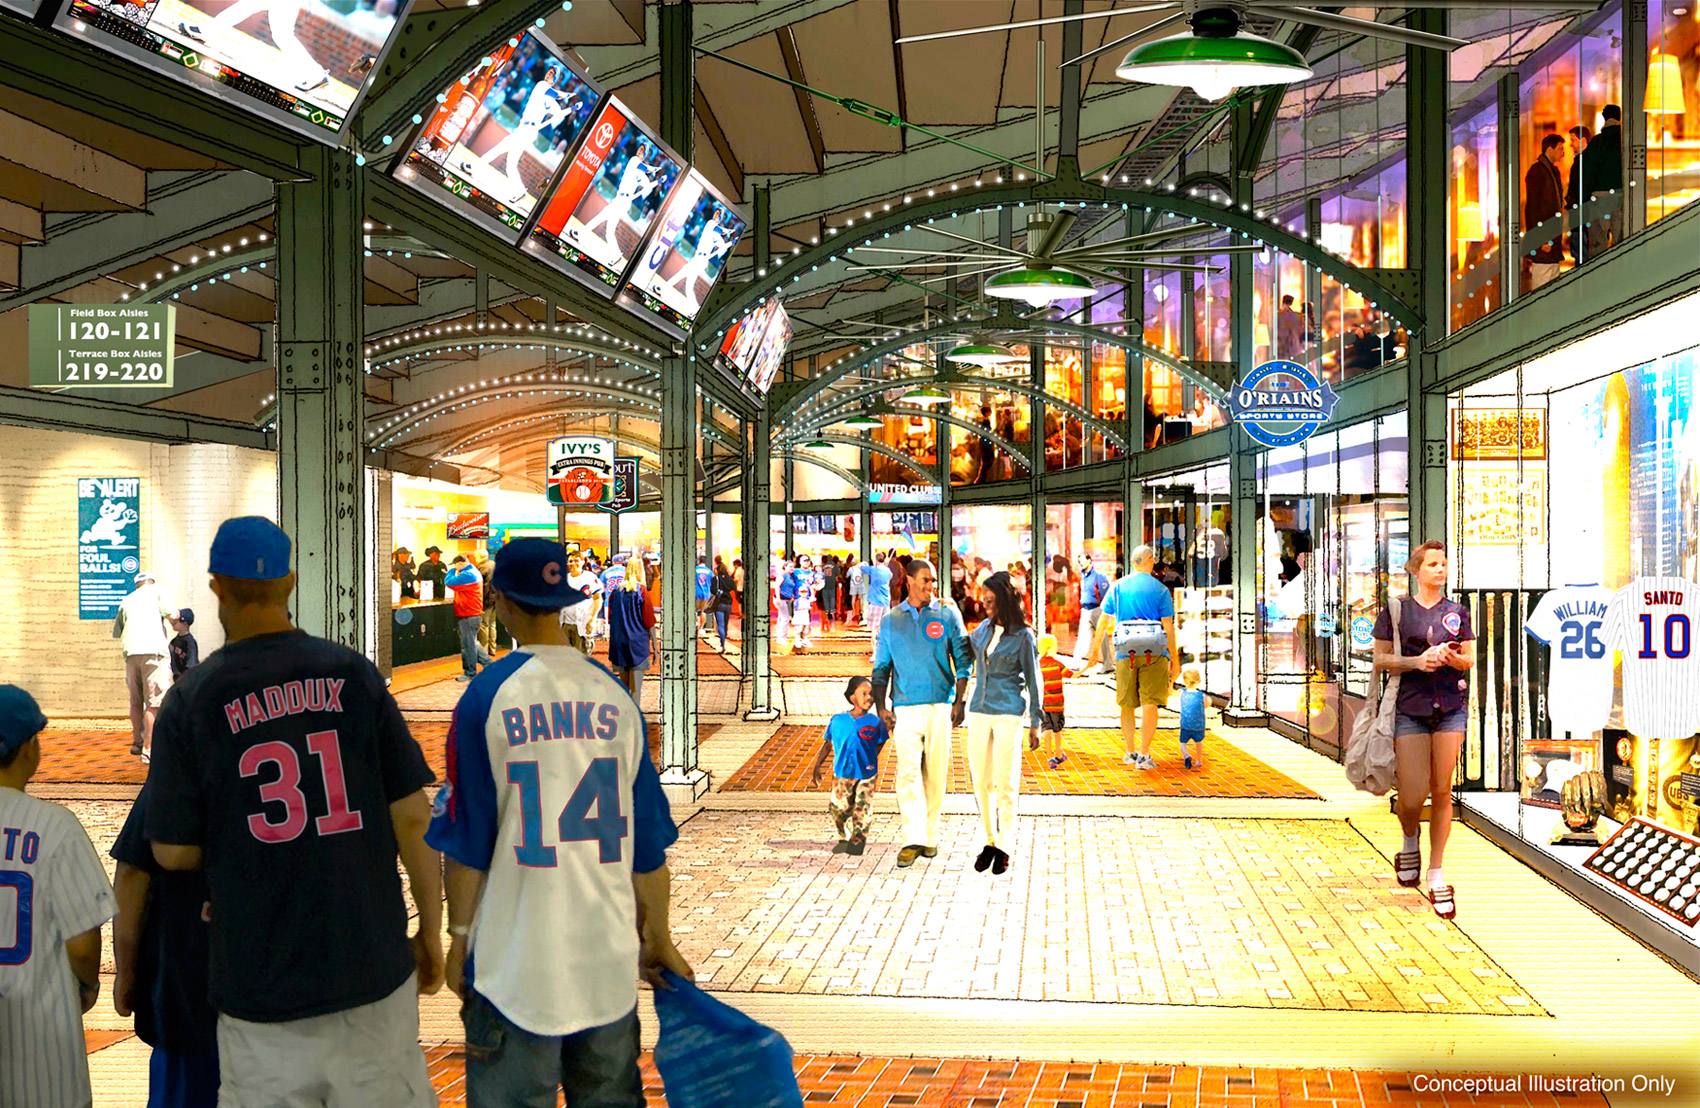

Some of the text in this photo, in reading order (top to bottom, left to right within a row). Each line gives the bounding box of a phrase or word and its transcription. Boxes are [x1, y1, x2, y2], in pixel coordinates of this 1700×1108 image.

[581, 146, 602, 169] TOYOTA
[70, 309, 149, 317] Field Box Aisles
[70, 322, 160, 340] 120-121
[69, 350, 163, 358] Terrace Box Aisles
[65, 362, 163, 381] 219-220
[1239, 389, 1323, 409] O'RIAINS
[561, 443, 601, 454] IVY'S
[557, 459, 573, 467] EXTRA
[593, 459, 605, 467] PUB
[79, 478, 139, 497] BE ALERT
[869, 483, 934, 495] UNITED CLUB
[80, 545, 98, 553] FOR
[80, 553, 112, 563] FOUL
[80, 563, 122, 573] BALLS!
[1644, 591, 1683, 606] SANTO
[1561, 620, 1606, 660] 26
[1638, 613, 1691, 660] 10
[224, 678, 345, 734] MADDUX
[502, 701, 620, 747] BANKS
[238, 729, 363, 843] 31
[506, 757, 628, 868] 14
